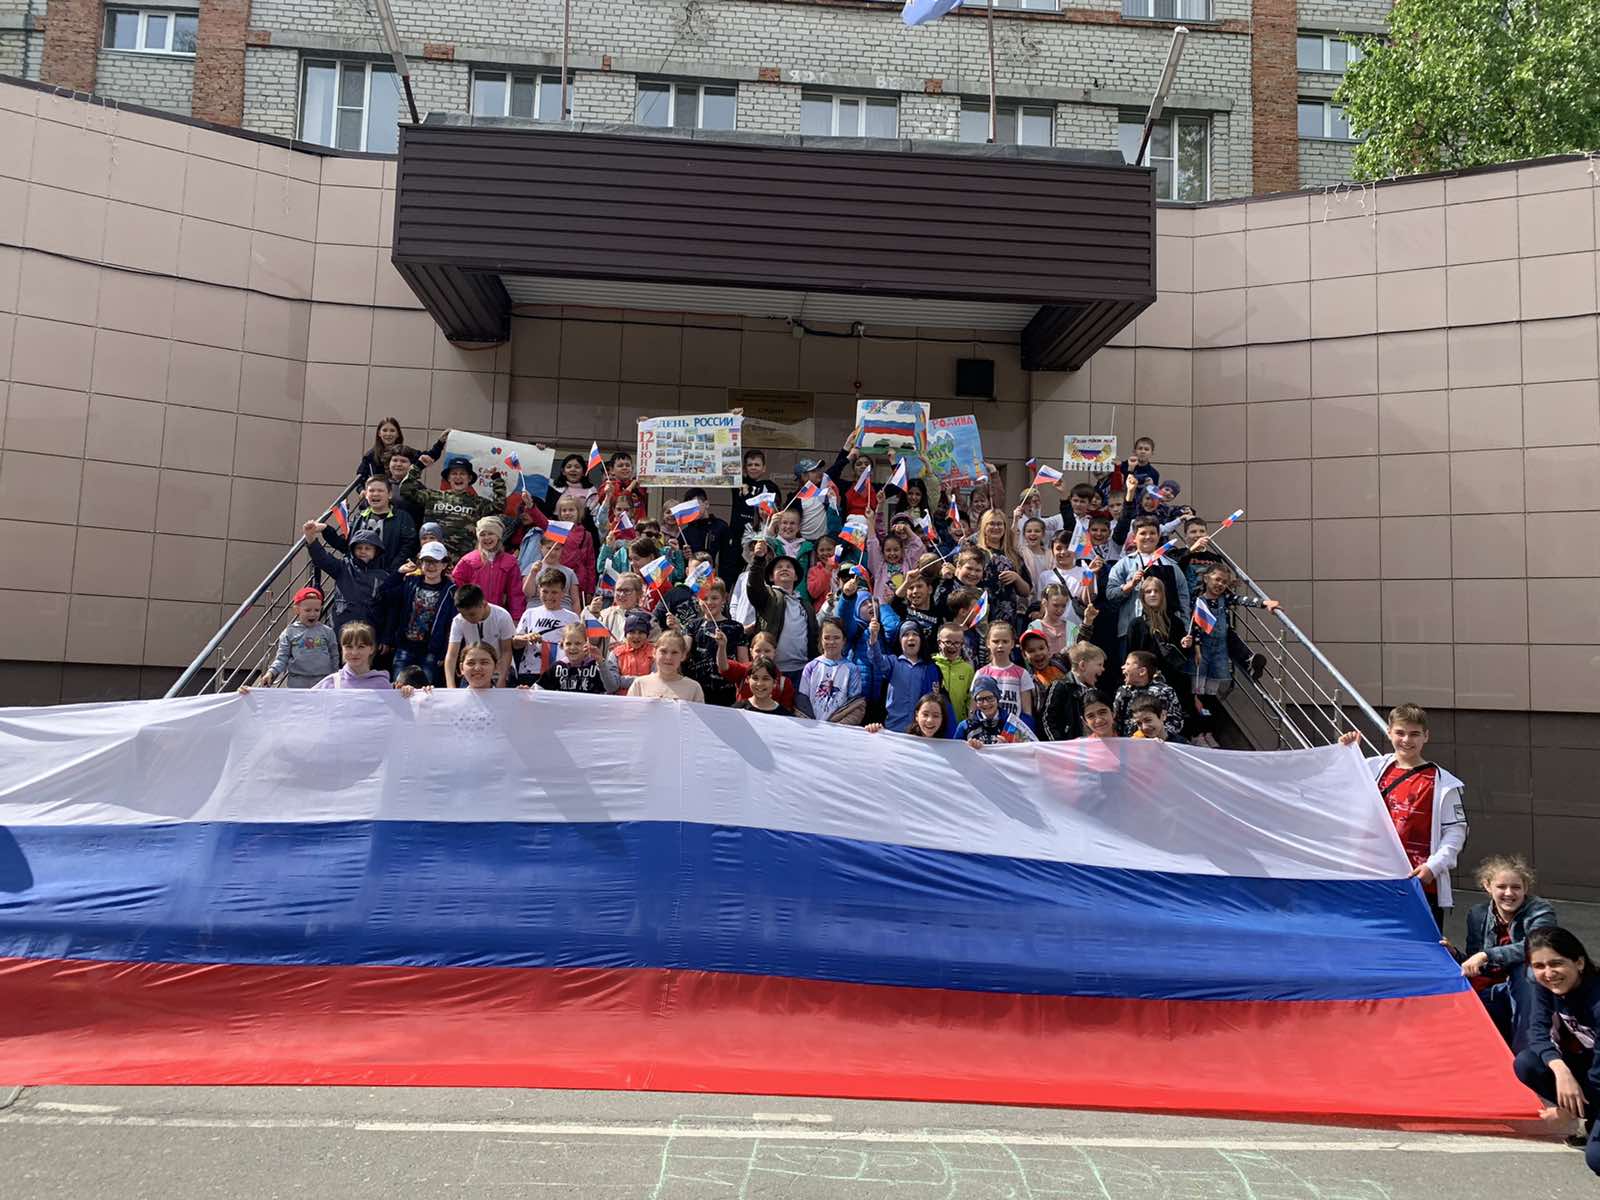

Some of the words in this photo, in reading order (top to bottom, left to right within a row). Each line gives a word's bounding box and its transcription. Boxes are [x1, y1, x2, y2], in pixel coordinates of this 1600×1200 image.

[656, 419, 689, 428] ДЕНЬ
[694, 416, 734, 427] РОССИИ
[640, 431, 654, 442] 12
[535, 617, 561, 628] NIKE
